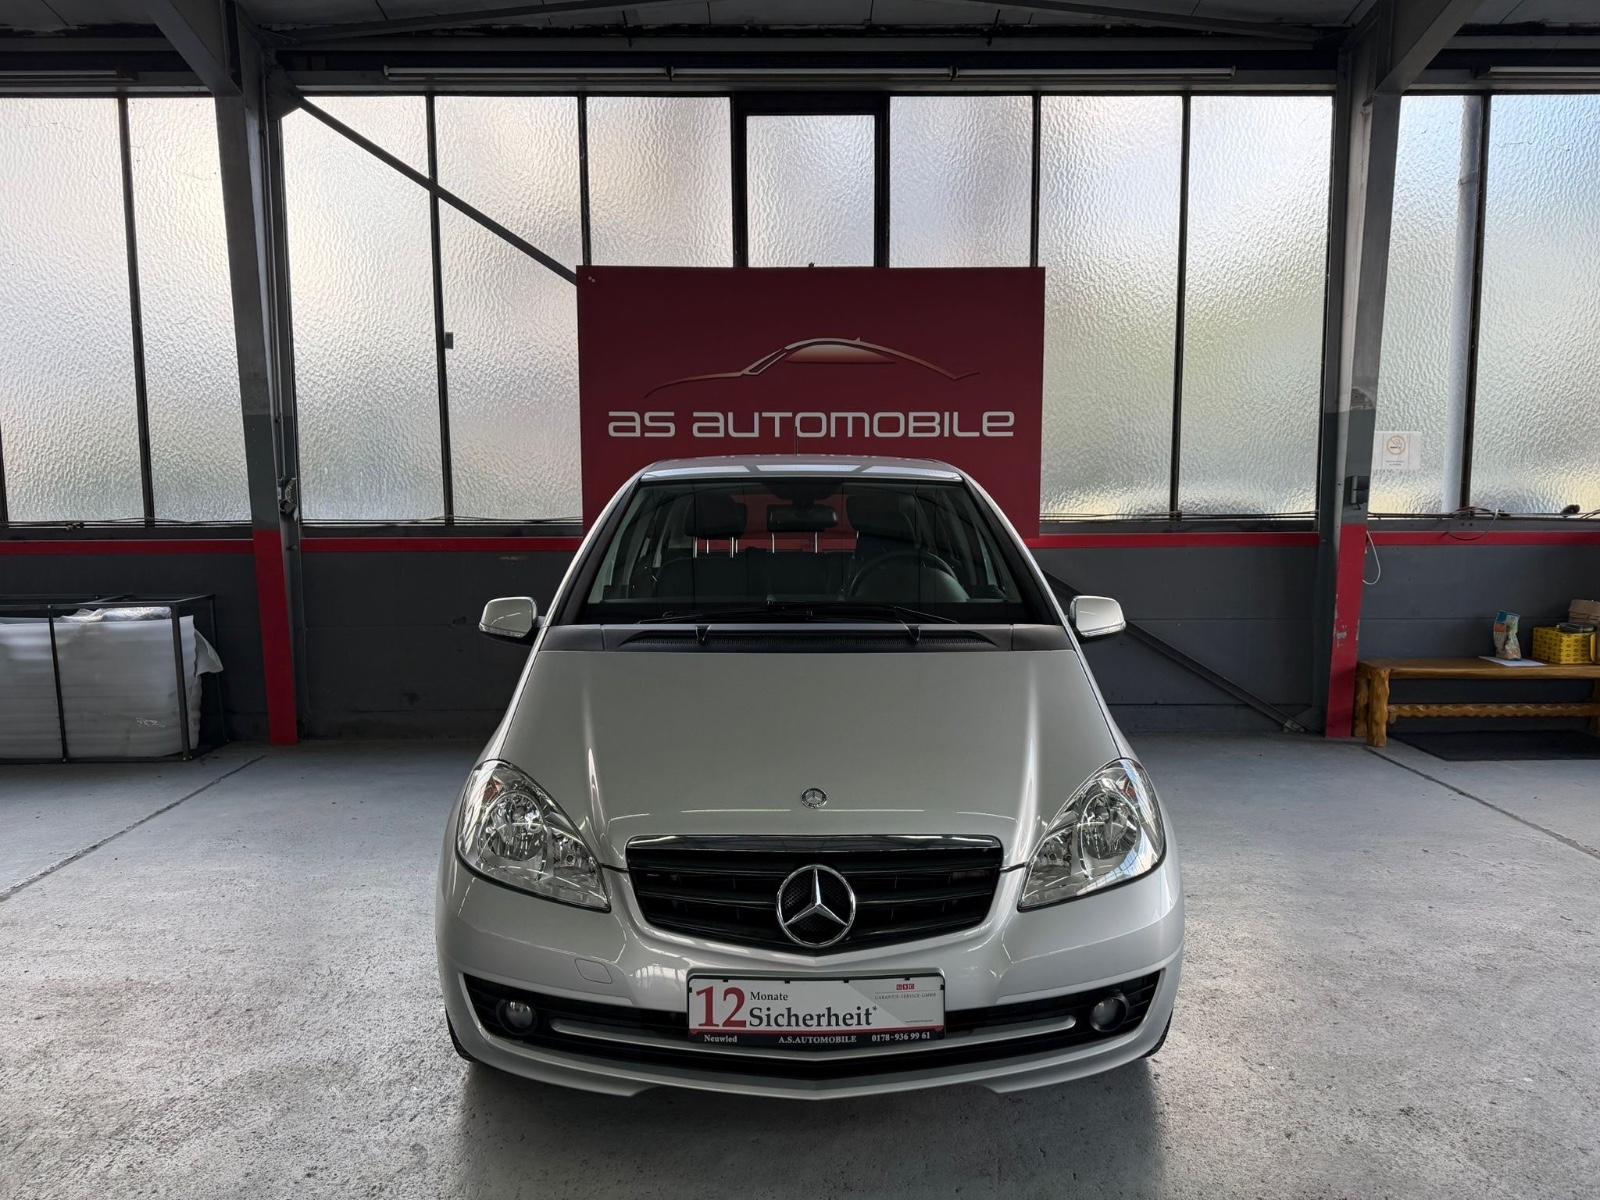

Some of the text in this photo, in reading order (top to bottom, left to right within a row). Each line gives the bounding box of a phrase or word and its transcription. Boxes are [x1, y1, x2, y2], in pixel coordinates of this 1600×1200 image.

[750, 991, 789, 1002] Monate
[696, 985, 747, 1028] 12
[704, 1034, 738, 1043] Neuwied
[778, 1035, 857, 1044] A.S.AUTOMOBILE
[871, 1032, 931, 1042] 0178-936 99 61
